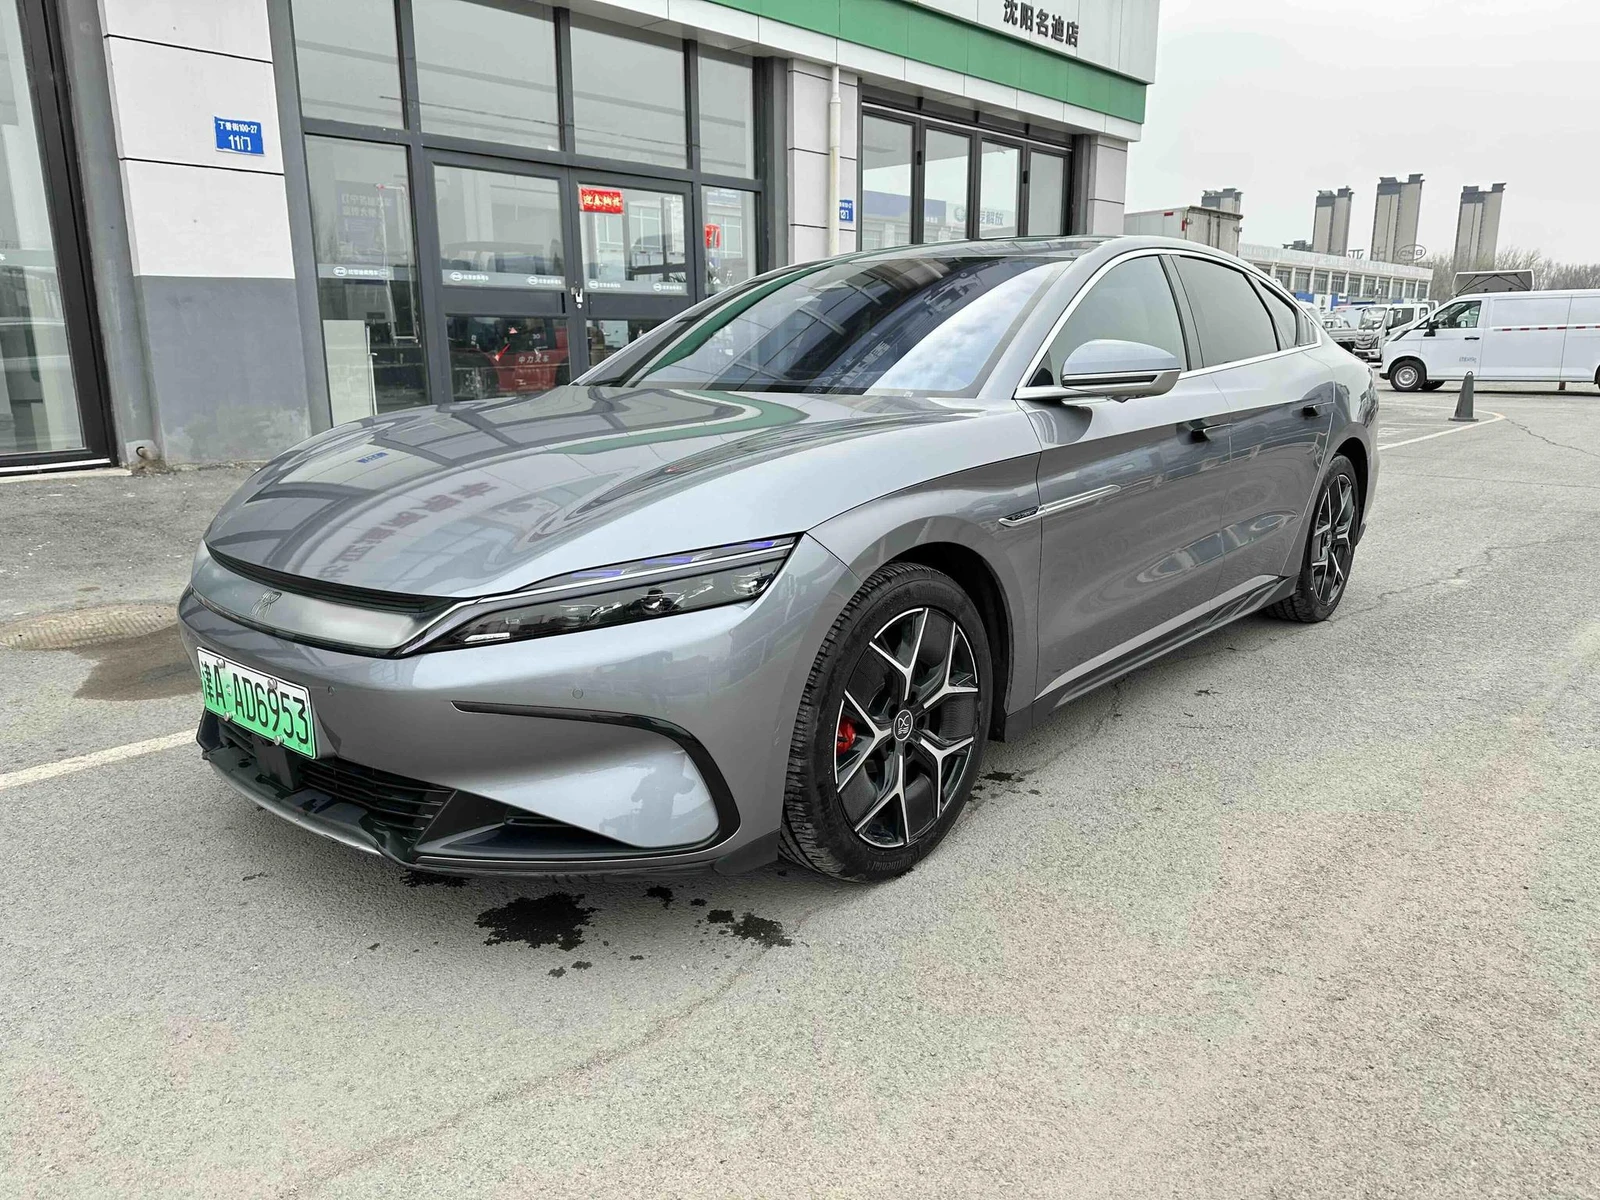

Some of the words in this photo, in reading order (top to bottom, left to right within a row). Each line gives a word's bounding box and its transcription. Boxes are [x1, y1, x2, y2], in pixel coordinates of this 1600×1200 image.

[1003, 0, 1079, 48] 沈阳名迪店
[228, 134, 252, 151] 11门
[232, 672, 310, 745] AD6953
